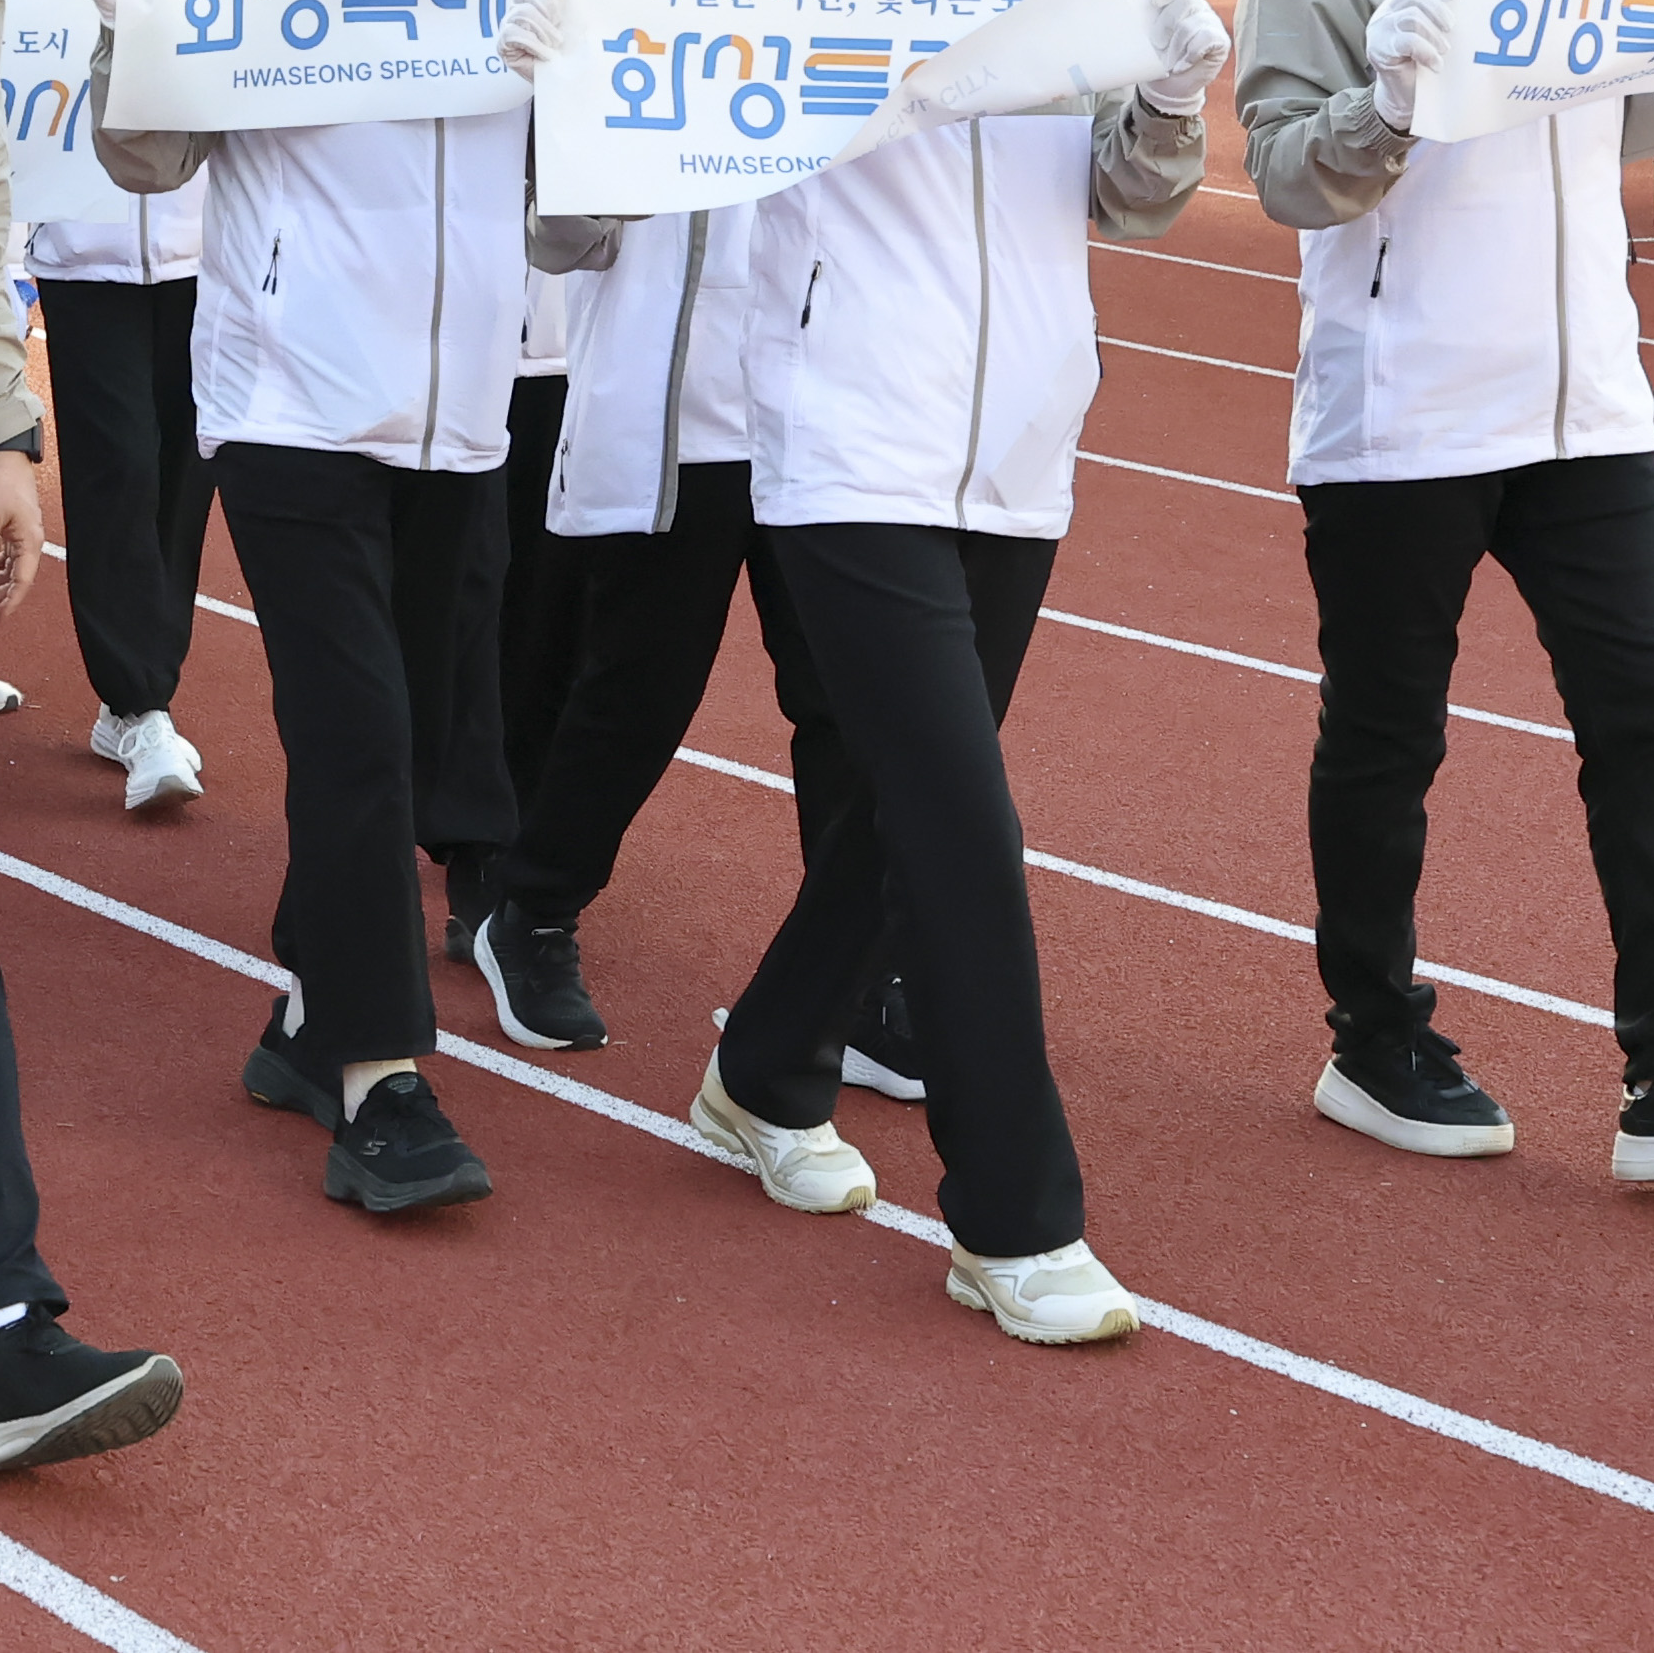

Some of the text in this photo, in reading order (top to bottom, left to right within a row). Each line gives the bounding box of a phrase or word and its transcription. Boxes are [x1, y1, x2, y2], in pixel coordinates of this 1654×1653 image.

[13, 28, 69, 59] 도시
[232, 55, 510, 89] HWASEONG SPECIAL CI
[601, 27, 951, 139] 화성특
